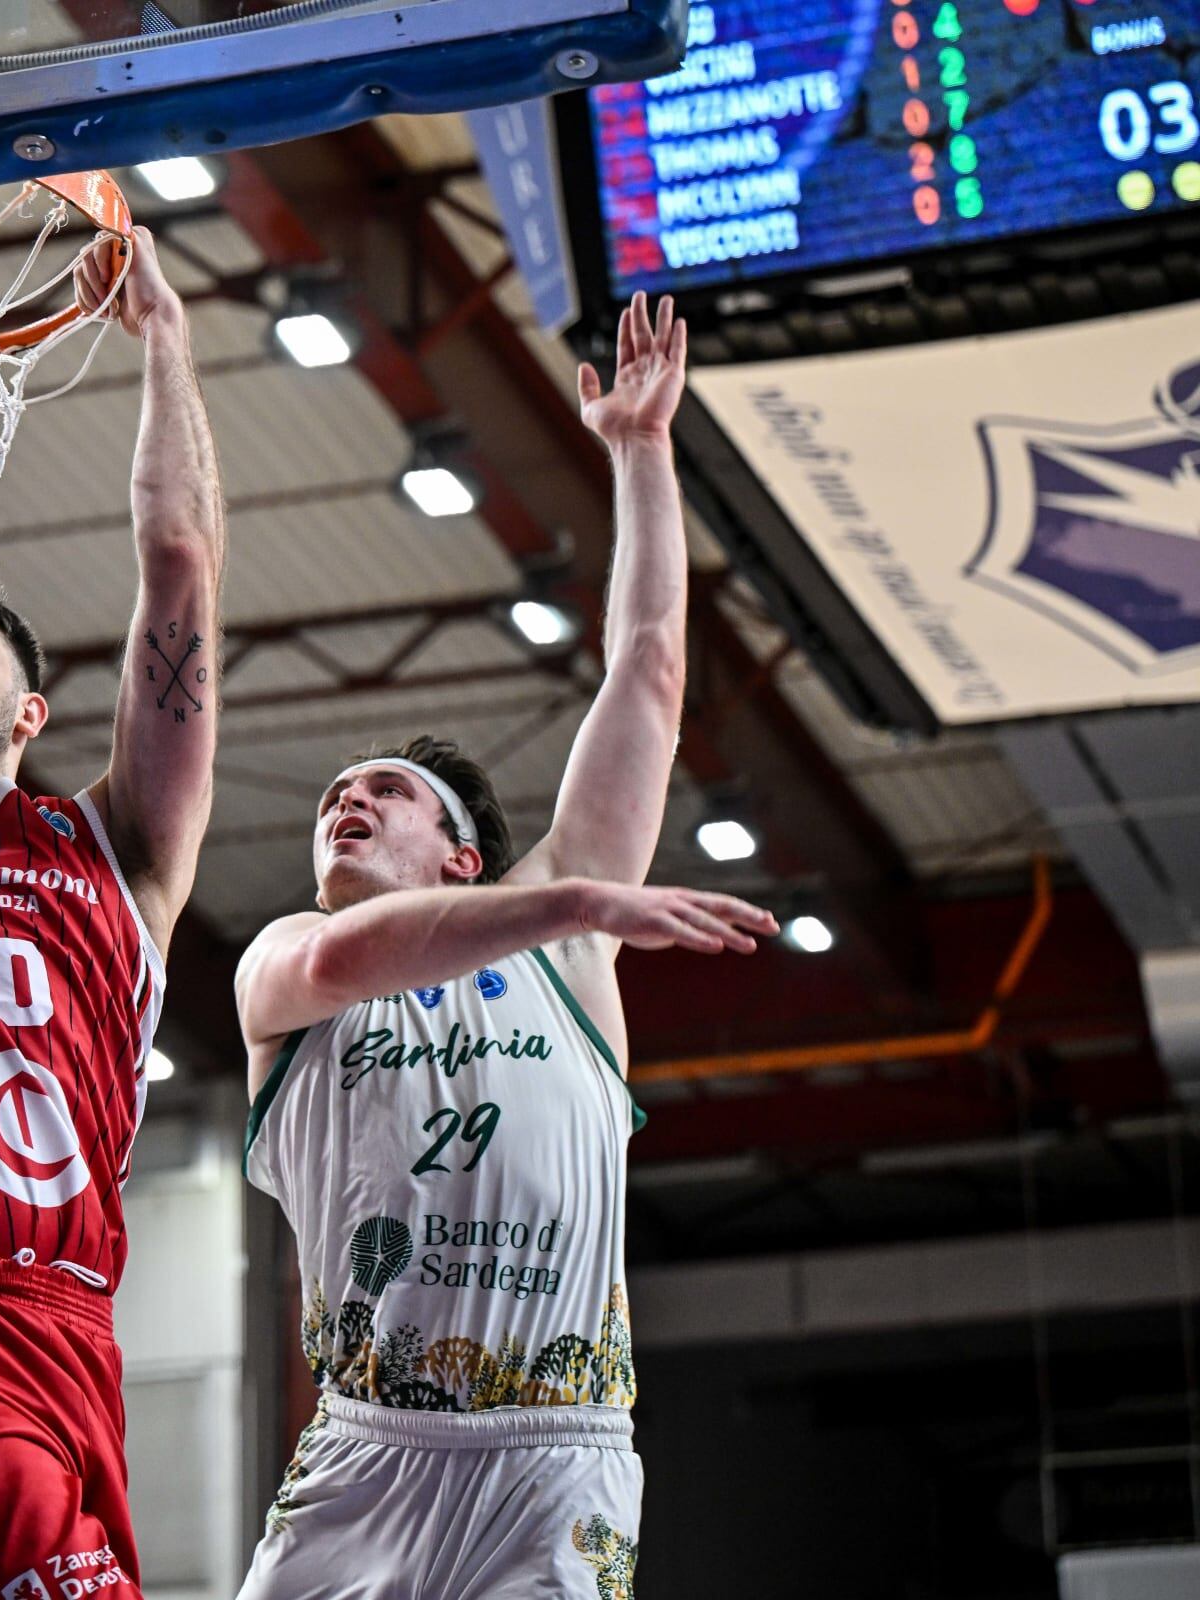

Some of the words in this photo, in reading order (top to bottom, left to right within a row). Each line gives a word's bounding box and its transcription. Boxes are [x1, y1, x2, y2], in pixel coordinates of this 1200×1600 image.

[892, 11, 919, 49] 0
[932, 2, 962, 42] 4
[646, 70, 842, 139] MEZZANOTTE
[902, 56, 920, 93] 1
[938, 46, 967, 88] 2
[1099, 81, 1199, 161] 03
[653, 126, 780, 182] THOMAS
[902, 98, 929, 137] 0
[943, 89, 969, 132] 7
[909, 142, 935, 182] 2
[660, 210, 799, 268] VISCONTI
[913, 185, 940, 225] 0
[174, 708, 186, 723] N
[341, 1022, 552, 1090] Sardinia
[410, 1102, 501, 1177] 29
[423, 1214, 529, 1249] Banco
[420, 1253, 561, 1299] Sardegna
